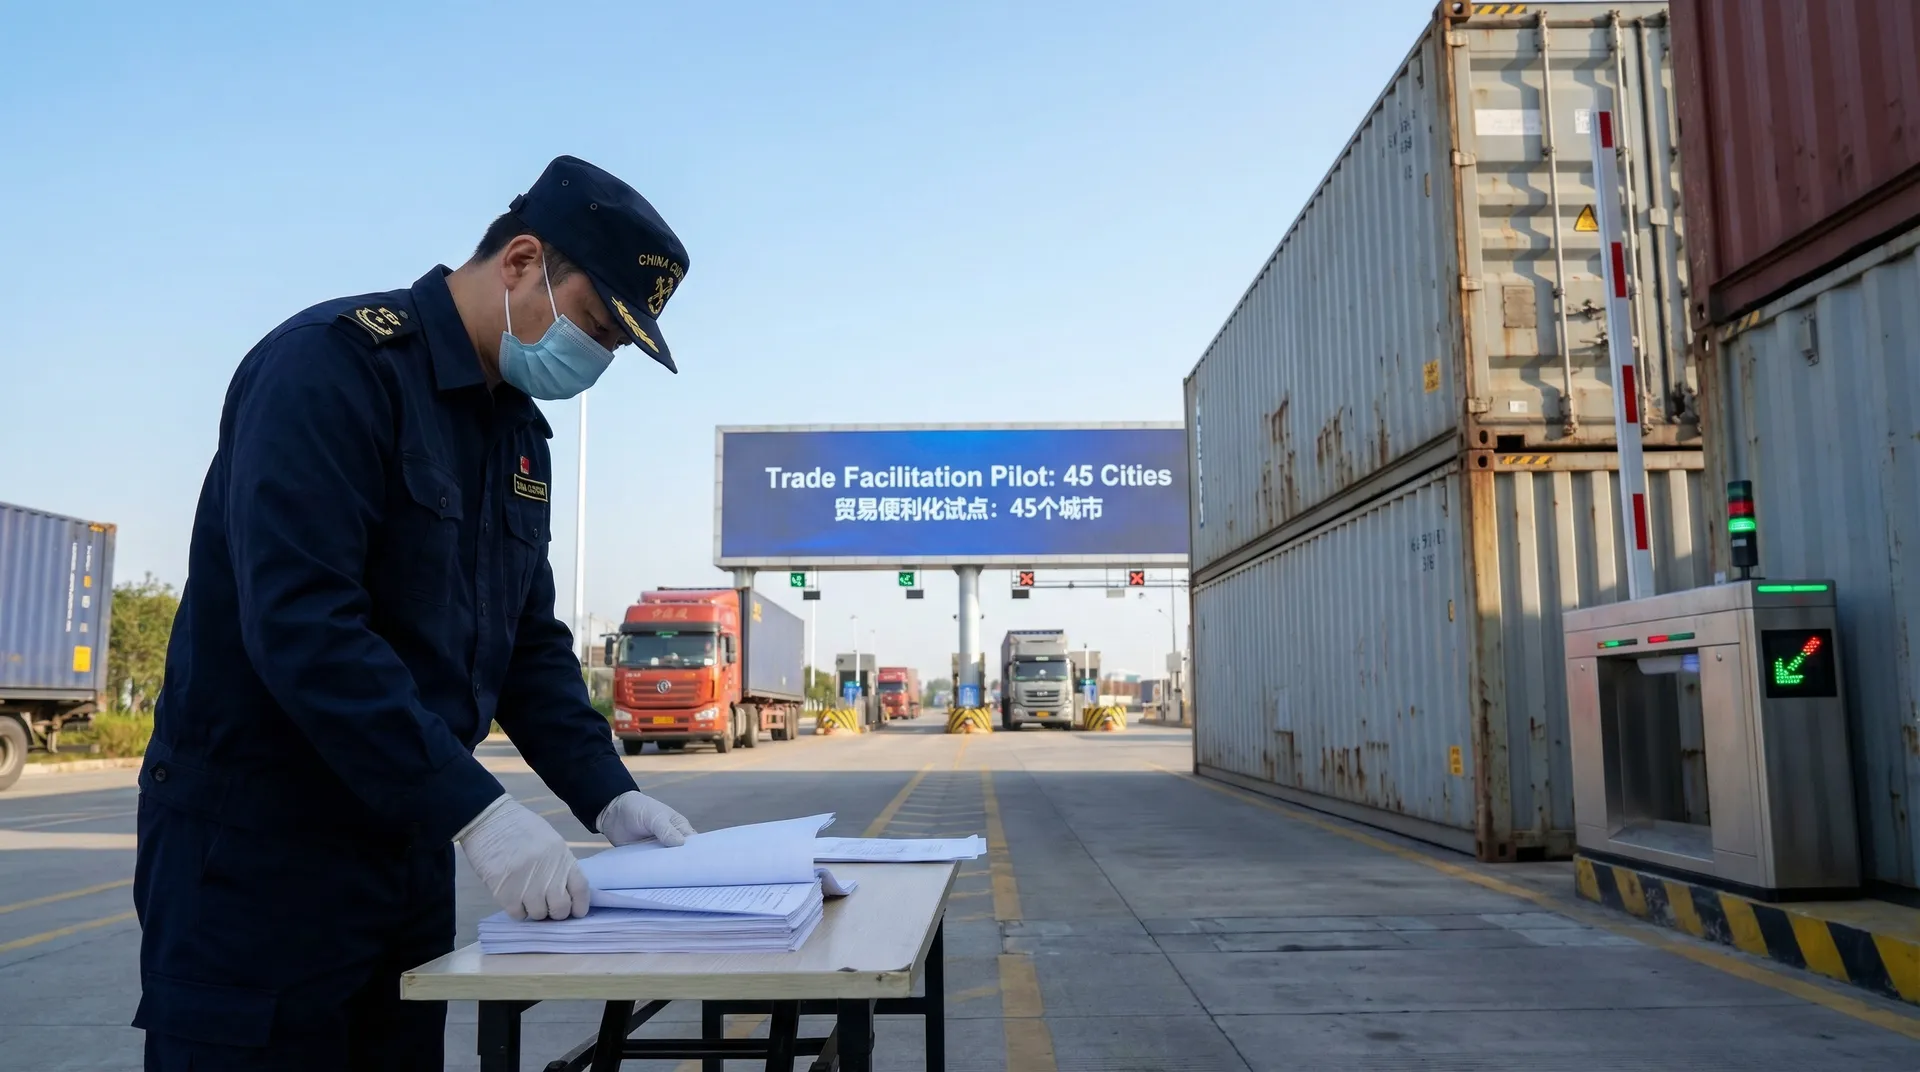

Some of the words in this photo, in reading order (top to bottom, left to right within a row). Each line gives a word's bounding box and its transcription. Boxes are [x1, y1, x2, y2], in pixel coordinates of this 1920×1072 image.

[638, 254, 669, 269] CHINA
[765, 466, 835, 489] Trade
[844, 465, 982, 488] Facilitation
[991, 464, 1055, 487] Pilot:
[1063, 464, 1093, 487] 45
[1101, 463, 1172, 486] Cities
[834, 496, 1103, 521] 贸易便利化试点：45个城市
